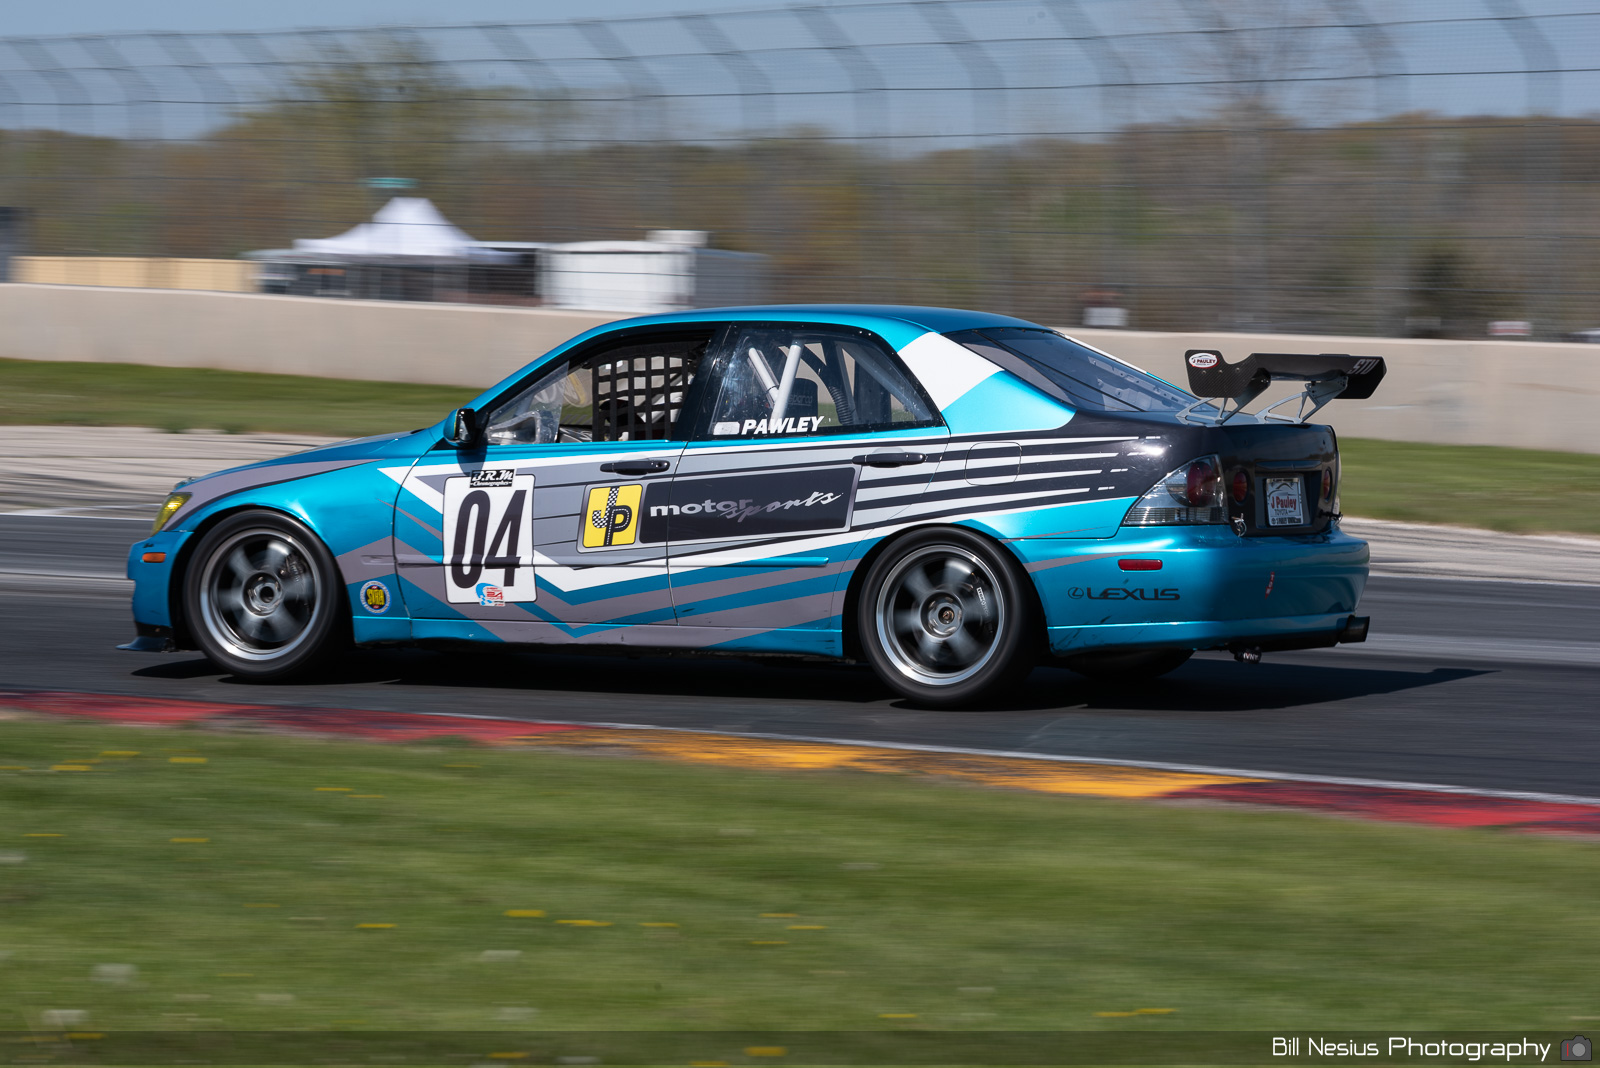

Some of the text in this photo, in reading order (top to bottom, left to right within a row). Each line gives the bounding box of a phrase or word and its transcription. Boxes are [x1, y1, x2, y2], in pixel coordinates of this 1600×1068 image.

[741, 416, 824, 434] PAWLEY
[1271, 496, 1296, 510] J Pauley
[451, 489, 527, 589] 04
[1086, 587, 1180, 601] LEXUS
